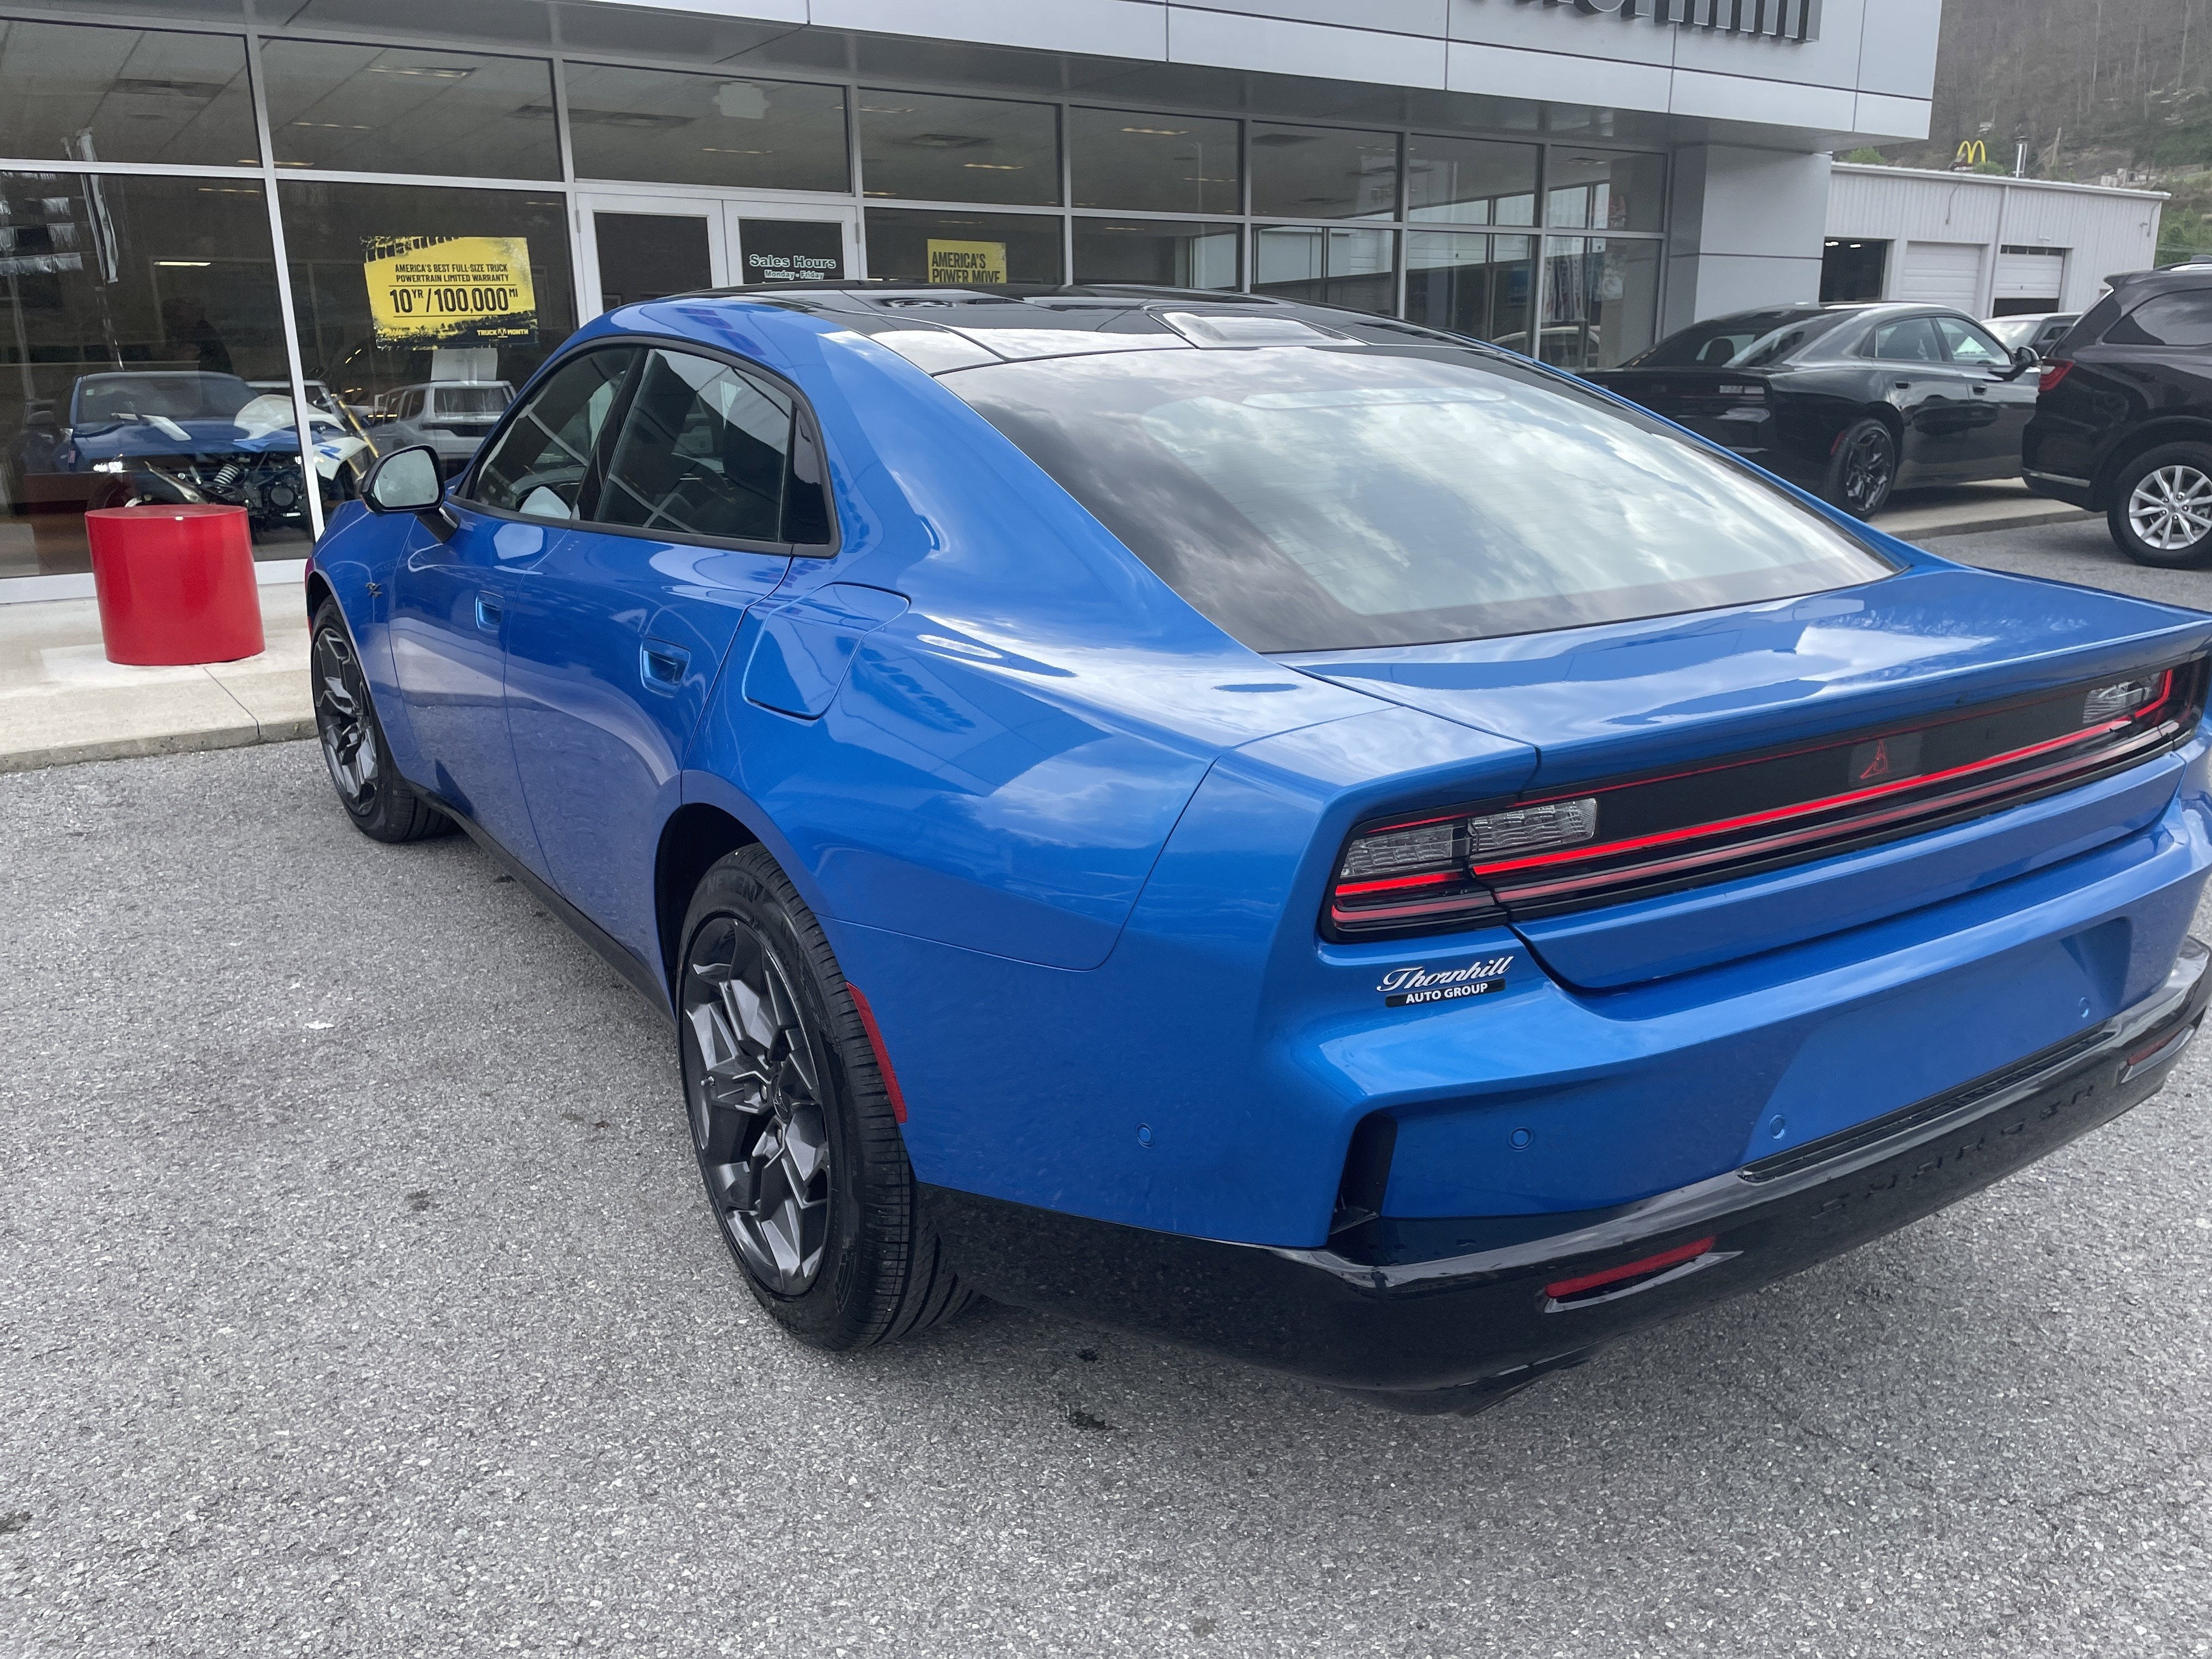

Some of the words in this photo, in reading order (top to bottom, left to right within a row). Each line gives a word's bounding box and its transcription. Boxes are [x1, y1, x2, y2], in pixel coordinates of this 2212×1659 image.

[749, 253, 791, 267] Sales
[793, 255, 837, 269] Hours
[932, 251, 986, 269] AMERICA'S
[395, 264, 432, 273] AMERICA'S
[433, 264, 450, 272] BEST
[452, 264, 484, 273] FULL-SIZE
[486, 263, 508, 272] TRUCK
[764, 269, 795, 280] Monday
[800, 270, 825, 280] Friday
[932, 268, 969, 283] POWER
[972, 270, 1000, 283] MOVE
[396, 274, 442, 283] POWERTRAIN
[472, 274, 509, 282] WARRANTY
[1376, 956, 1514, 992] Thornhill
[1406, 990, 1441, 1004] AUTO
[1443, 983, 1488, 998] GROUP
